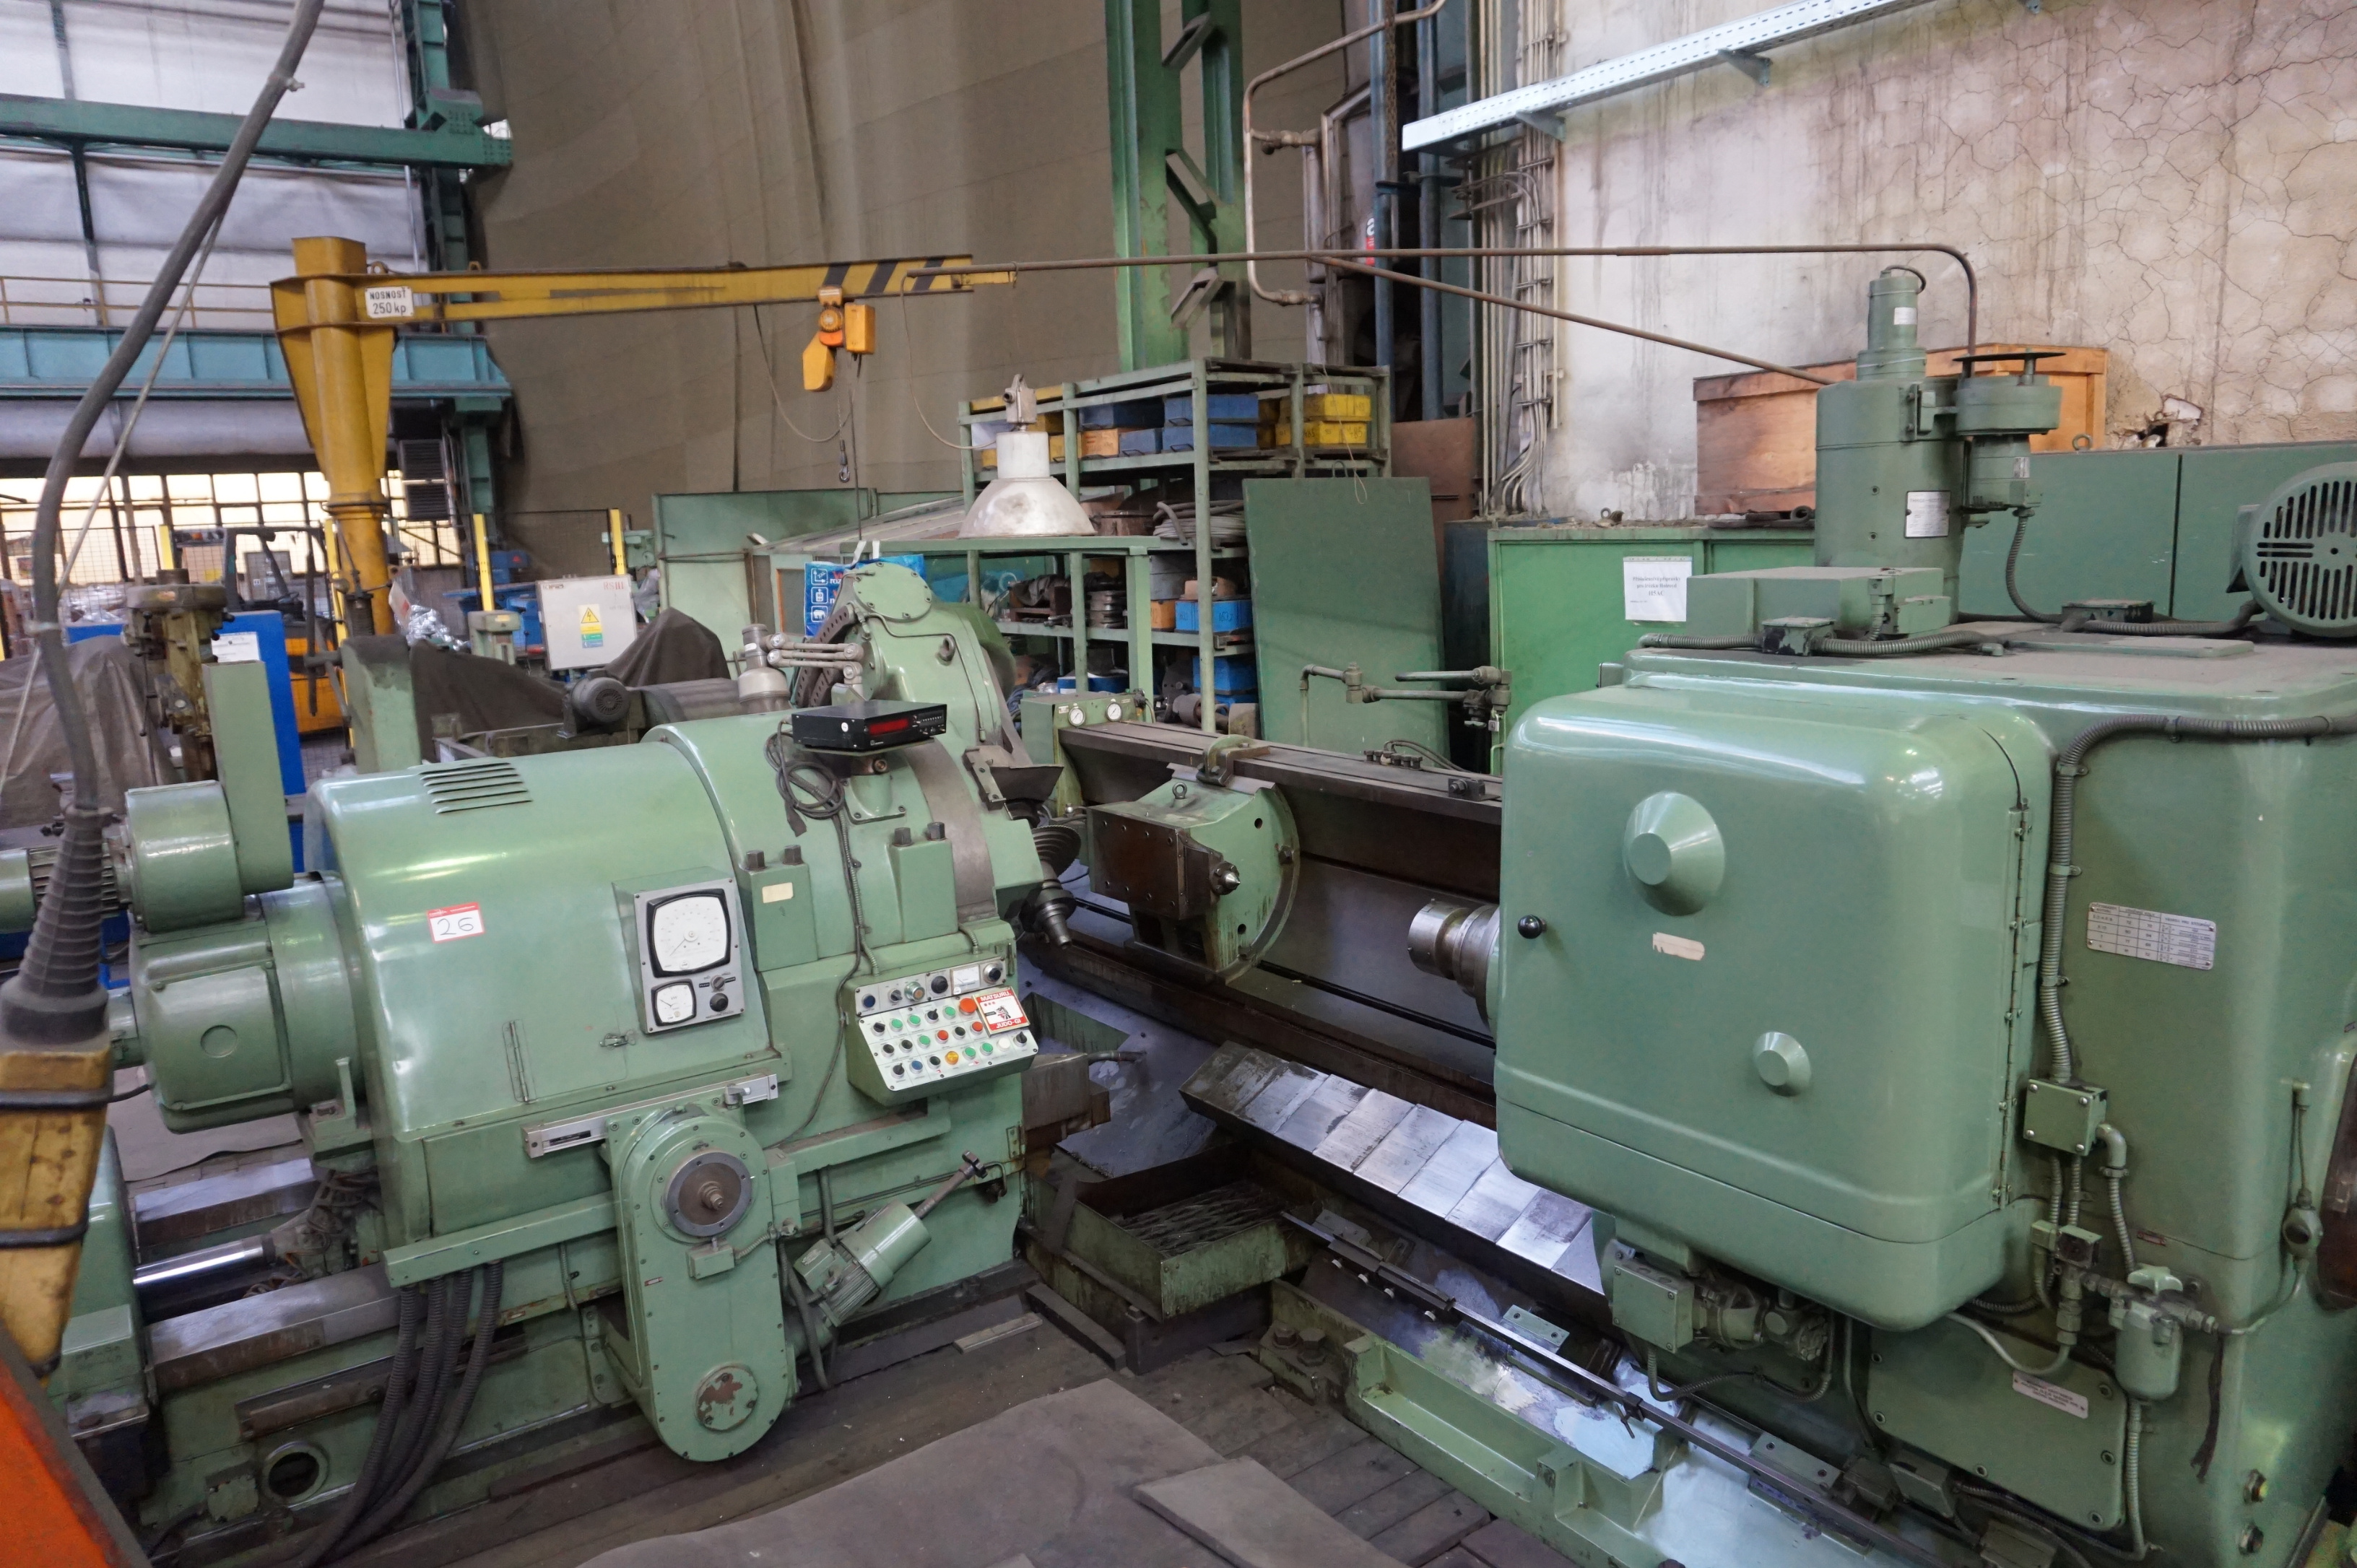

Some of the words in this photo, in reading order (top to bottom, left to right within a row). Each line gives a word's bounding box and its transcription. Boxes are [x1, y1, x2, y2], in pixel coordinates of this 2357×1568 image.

[373, 302, 392, 315] 250
[394, 302, 407, 315] kp
[437, 917, 474, 936] 26
[980, 990, 1010, 1001] MATSURU
[996, 1018, 1021, 1029] JUDO-GI
